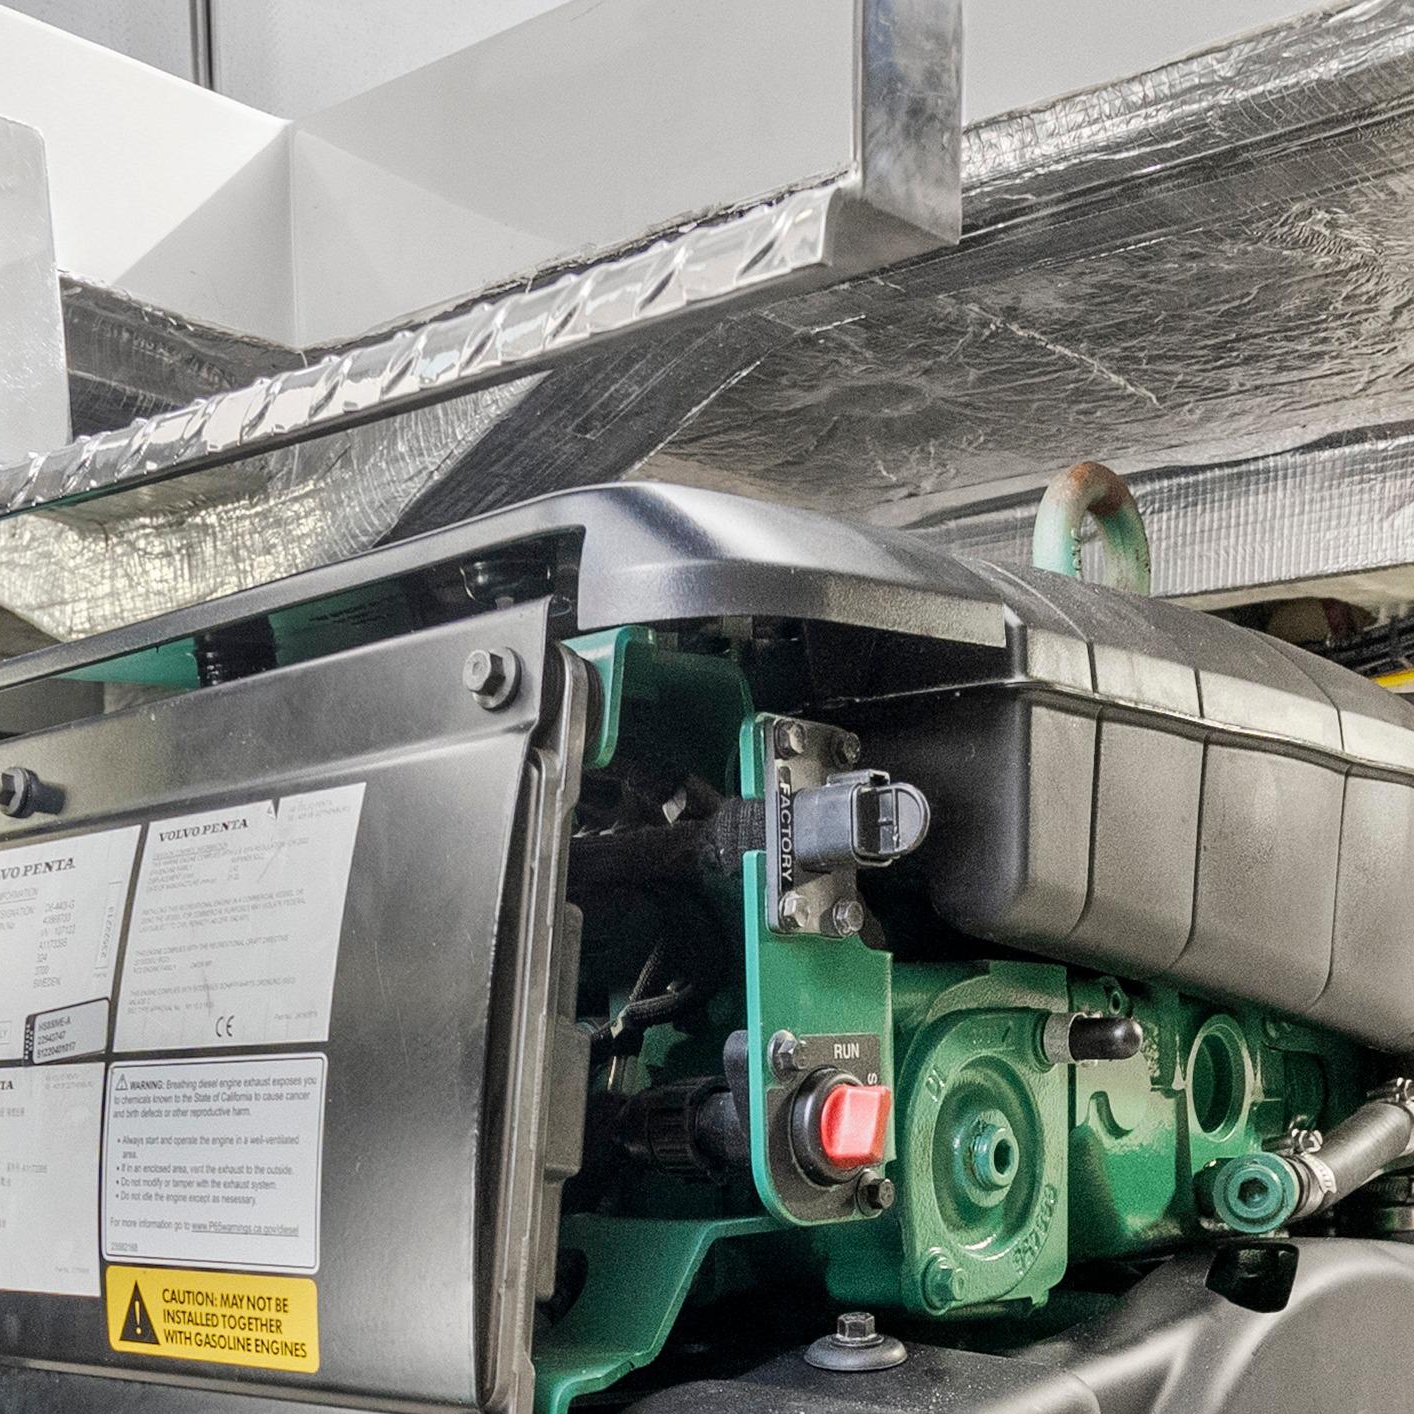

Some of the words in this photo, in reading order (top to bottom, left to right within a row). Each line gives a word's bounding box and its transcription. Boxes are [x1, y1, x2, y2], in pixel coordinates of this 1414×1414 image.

[158, 827, 200, 842] VOLVO
[202, 819, 249, 835] PENTA
[779, 782, 793, 881] FACTORY
[23, 855, 76, 876] PENTA
[834, 1043, 859, 1059] RUN
[129, 1080, 165, 1089] WARNING:
[166, 1078, 197, 1091] Breathing
[198, 1078, 218, 1088] diesel
[219, 1078, 242, 1089] engine
[243, 1076, 270, 1086] exhaust
[272, 1076, 301, 1087] exposes
[303, 1076, 316, 1087] you
[114, 1095, 120, 1104] to
[121, 1095, 151, 1104] chemicals
[152, 1094, 173, 1103] known
[174, 1094, 181, 1102] to
[182, 1094, 192, 1102] the
[194, 1093, 211, 1102] State
[212, 1093, 220, 1102] of
[220, 1092, 252, 1101] California
[254, 1092, 261, 1101] to
[262, 1092, 283, 1100] cause
[285, 1092, 310, 1100] cancer
[162, 1289, 217, 1307] CAUTION:
[220, 1294, 245, 1308] MAY
[246, 1296, 272, 1311] NOT
[275, 1298, 289, 1313] BE
[163, 1309, 218, 1327] INSTALLED
[222, 1315, 282, 1334] TOGETHER
[164, 1329, 192, 1345] WITH
[194, 1333, 251, 1351] GASOLINE
[254, 1338, 307, 1357] ENGINES
